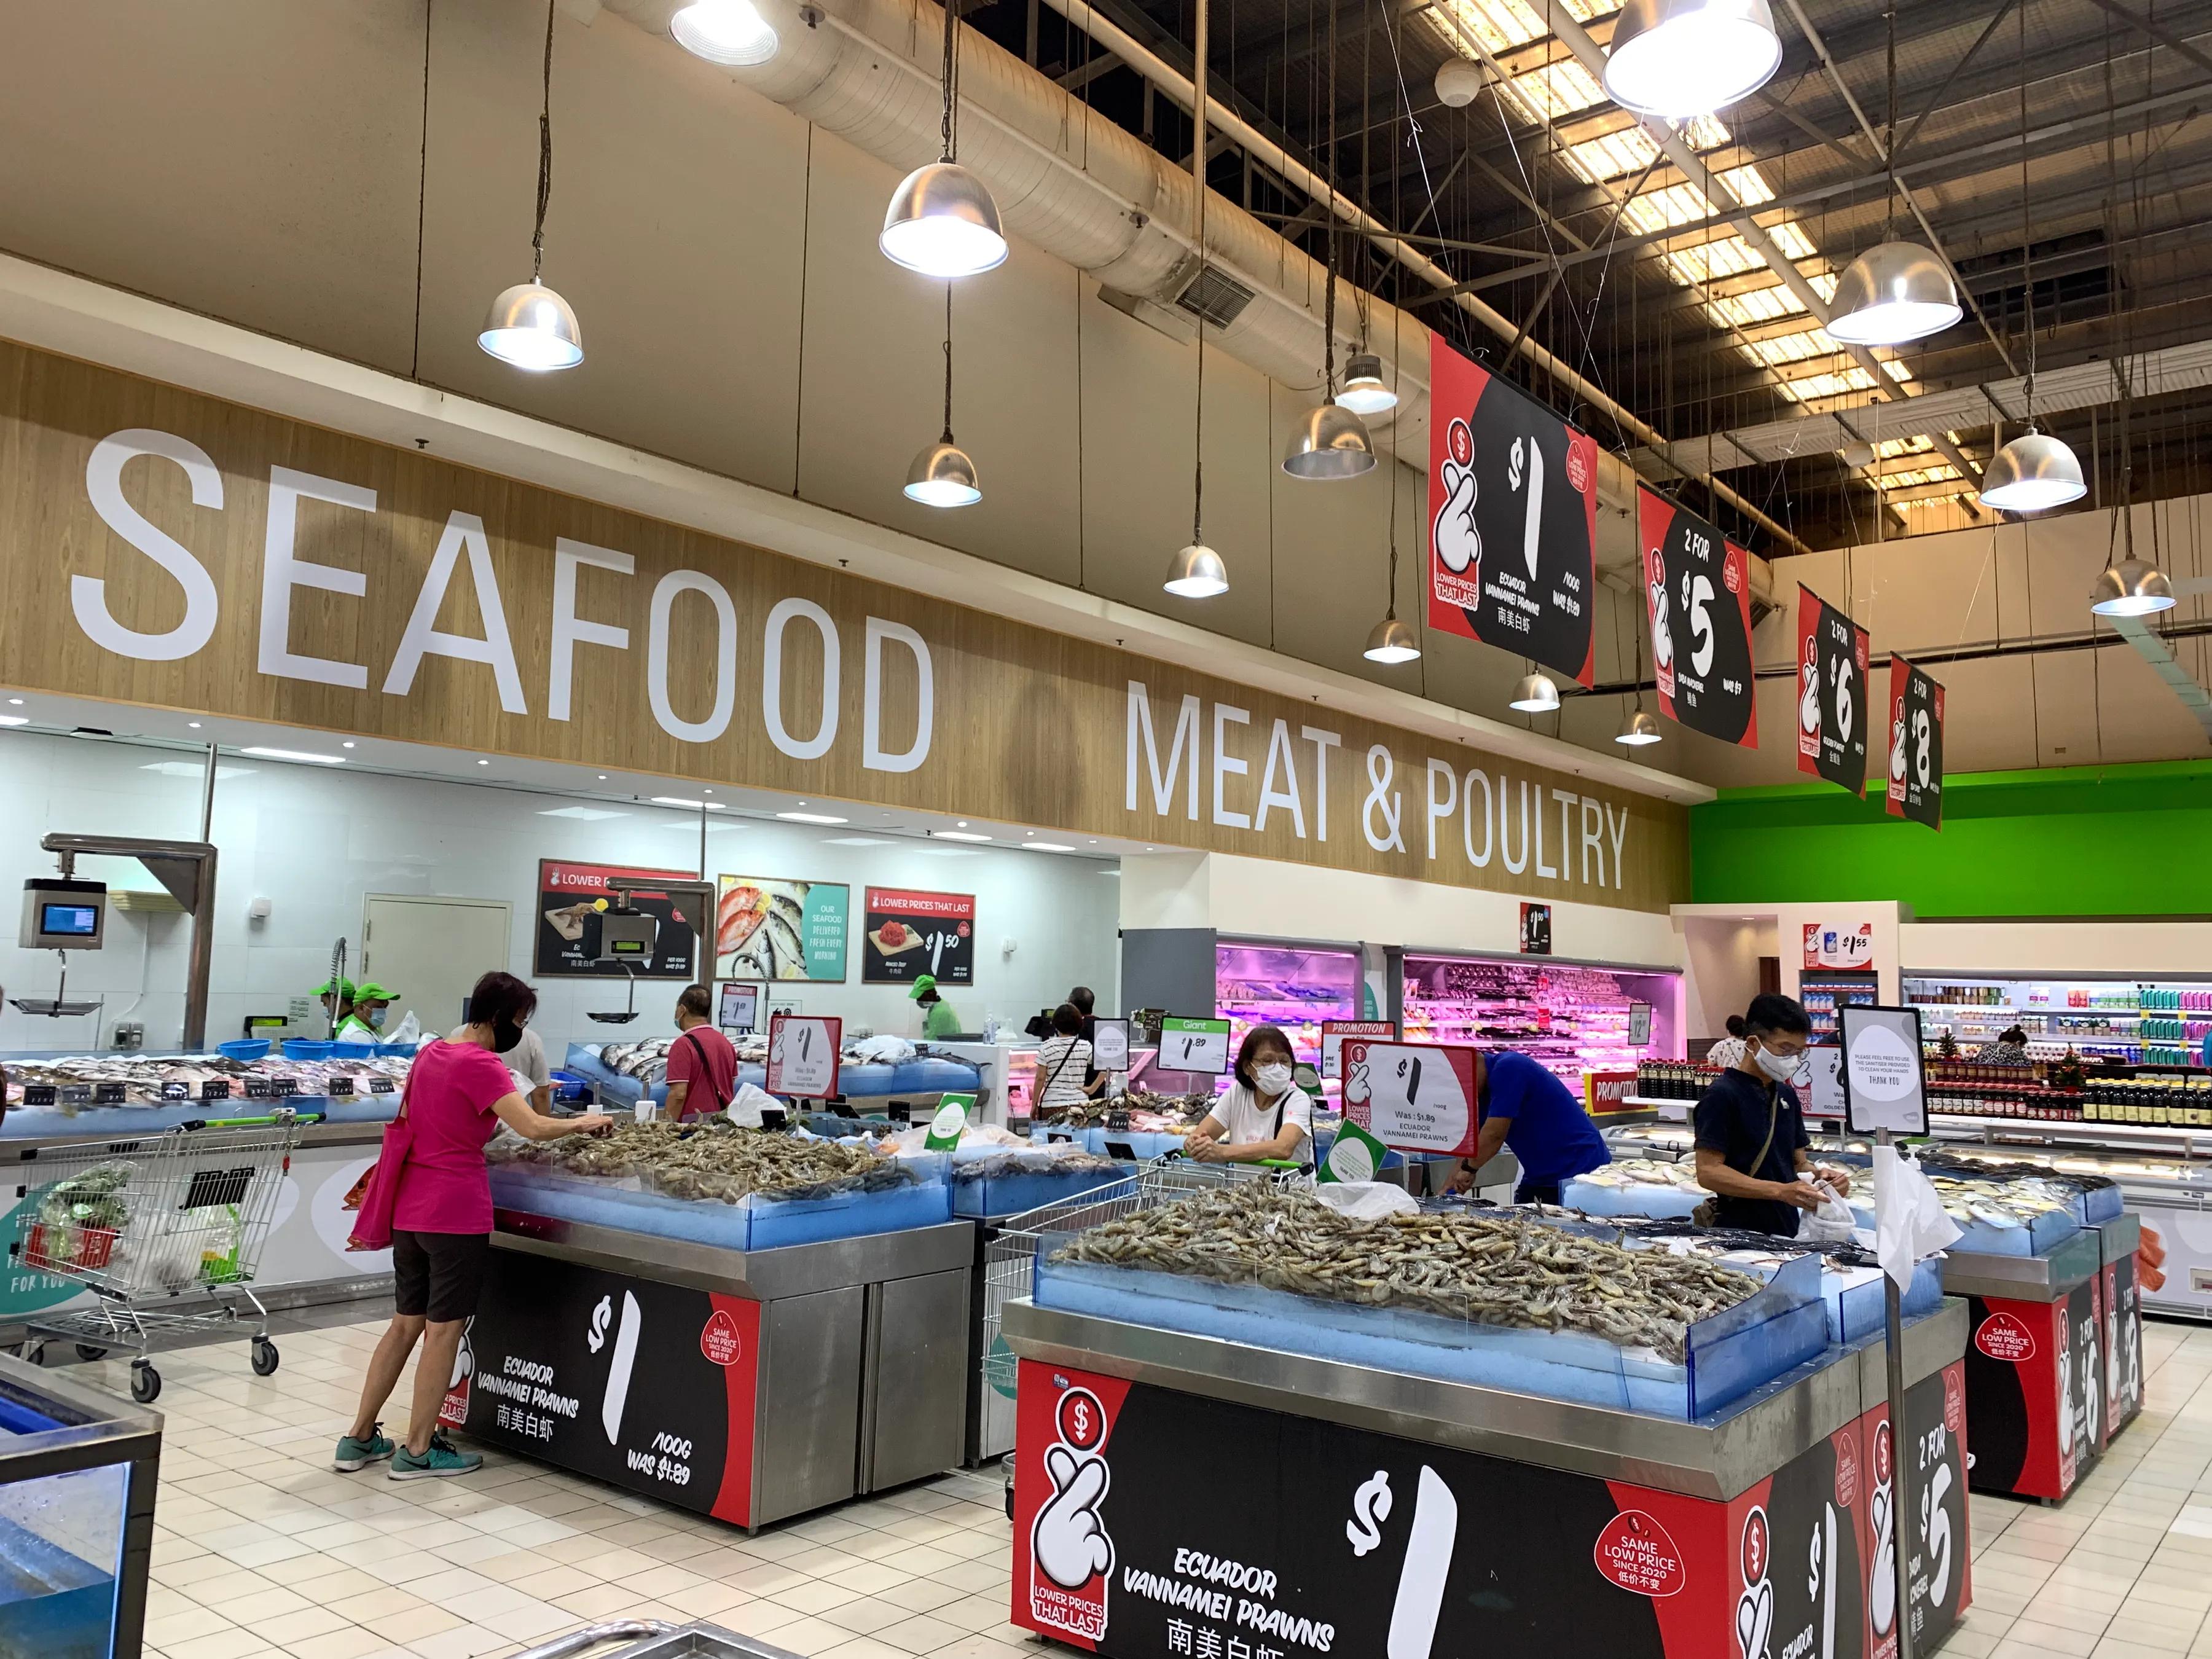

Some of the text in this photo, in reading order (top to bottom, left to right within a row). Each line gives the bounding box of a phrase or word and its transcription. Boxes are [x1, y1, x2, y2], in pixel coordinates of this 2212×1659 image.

[1685, 528, 1710, 563] 2 FOR
[1437, 572, 1477, 592] LOWER PRICES
[1499, 571, 1526, 594] ECUADOR
[71, 428, 934, 772] SEAFOOD
[1437, 582, 1477, 607] THAT LAST
[1485, 582, 1540, 616] VANNAMEI PRAWNS
[1553, 590, 1566, 610] WAS
[1497, 606, 1530, 634] 南美白虾
[1681, 571, 1715, 677] $5
[1832, 621, 1848, 646] 2 FOR
[1830, 653, 1853, 743] $6
[1914, 678, 1926, 700] 2 FOR
[1912, 708, 1931, 788] $8
[1126, 679, 1628, 890] MEAT & POULTRY
[562, 874, 602, 887] LOWER
[820, 904, 835, 913] OUR
[880, 898, 970, 912] LOWER PRICES THAT LAST
[812, 914, 842, 923] SEAFOOD
[813, 925, 841, 935] DELIVERED
[945, 934, 959, 948] 50
[809, 938, 842, 947] FRESH EVERY
[1856, 938, 1867, 947] 55
[1183, 1020, 1207, 1030] Giant
[1332, 1023, 1386, 1033] PROMOTION
[1597, 1080, 1638, 1102] PROMOTIO
[1869, 1076, 1900, 1086] THANK YOU
[1395, 1111, 1435, 1123] Was $1.89
[1400, 1123, 1431, 1131] ECUADOR
[1382, 1129, 1448, 1142] VANNAMEI PRAWNS
[10, 1275, 36, 1293] FOR
[705, 1334, 737, 1348] LOW PRICE
[713, 1328, 730, 1338] SAME
[1982, 1333, 2030, 1346] LOW PRICE
[1992, 1328, 2018, 1337] SAME
[2080, 1315, 2093, 1347] 2 FOR
[503, 1355, 554, 1387] ECUADOR
[587, 1290, 641, 1446] $1
[449, 1394, 466, 1408] PRICES
[477, 1371, 579, 1419] VANNAMEI PRAWNS
[449, 1404, 466, 1420] LAST
[497, 1403, 554, 1443] 南美白虾
[651, 1431, 692, 1460] /100G
[1920, 1422, 1946, 1471] 2 FOR
[627, 1449, 691, 1486] WAS $1.89
[1621, 1536, 1658, 1555] SAME
[1921, 1463, 1951, 1607] $5
[1347, 1465, 1458, 1659] $1
[1605, 1544, 1676, 1571] LOW PRICE
[1174, 1547, 1277, 1600] ECUADOR
[1613, 1559, 1667, 1579] SINCE 2020
[1618, 1571, 1660, 1590] 低价不变
[1034, 1585, 1104, 1617] LOWER PRICES
[1123, 1566, 1335, 1652] VANNAMEI PRAWNS
[1035, 1599, 1104, 1634] THAT LAST
[1783, 1624, 1813, 1659] ECUADOR
